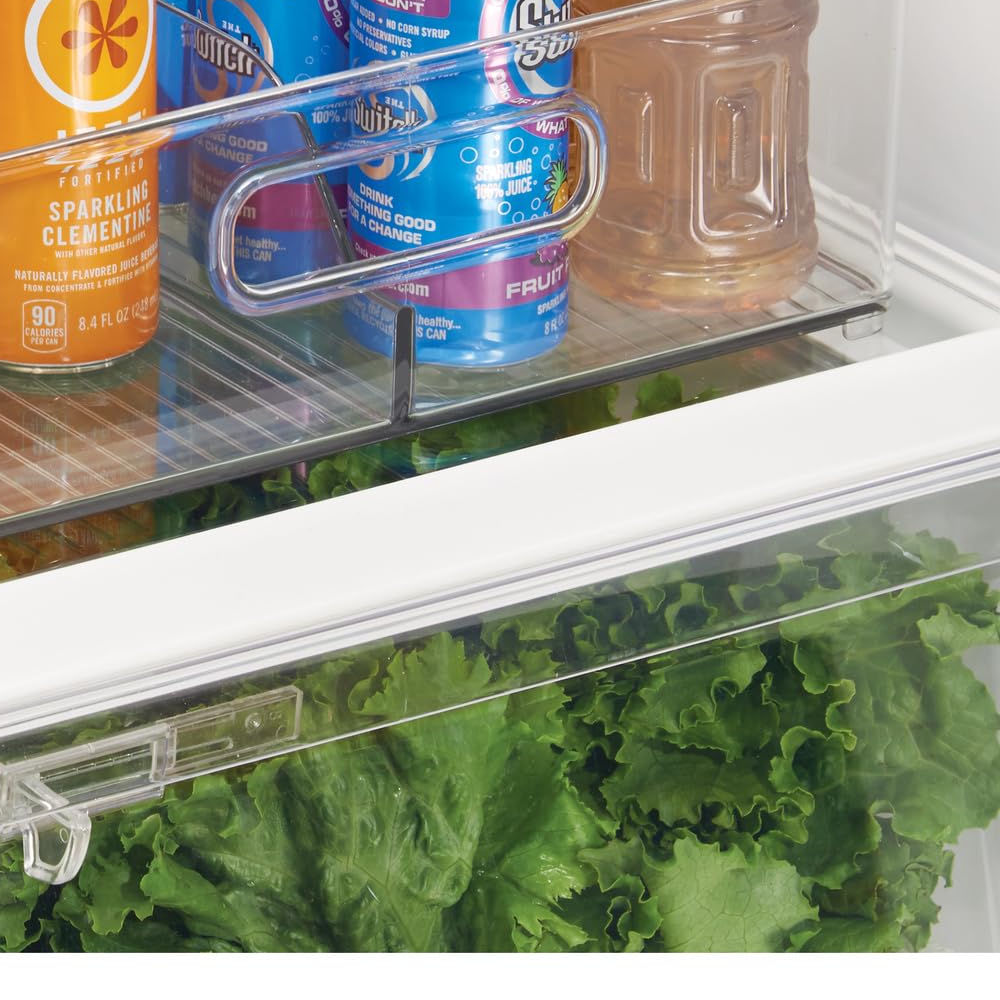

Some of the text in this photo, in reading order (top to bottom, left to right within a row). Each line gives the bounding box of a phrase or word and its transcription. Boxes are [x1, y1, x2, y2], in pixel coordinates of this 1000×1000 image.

[363, 21, 412, 50] PRESERVATIVES
[398, 22, 450, 40] CORN SYRUP
[229, 135, 268, 152] GOOD
[59, 157, 144, 188] FORTIFIED
[359, 182, 394, 208] DRINK
[506, 176, 532, 197] JUICE
[49, 179, 148, 222] SPARKLING
[42, 201, 152, 247] CLEMENTINE
[368, 220, 423, 246] CHANGE
[394, 213, 437, 232] GOOD
[55, 239, 125, 259] WITH OTHER NATURAL
[252, 252, 273, 263] CAN
[14, 268, 69, 282] NATURALLY
[72, 264, 118, 281] FLAVORED
[120, 254, 139, 271] JUICE
[23, 282, 95, 293] FROM CONCENTRATE
[506, 264, 563, 299] FRUIT
[31, 305, 56, 327] 90
[78, 307, 129, 332] 8.4 FL OZ
[25, 327, 64, 338] CALORIES
[30, 337, 59, 346] PER CAN
[426, 328, 447, 341] CAN
